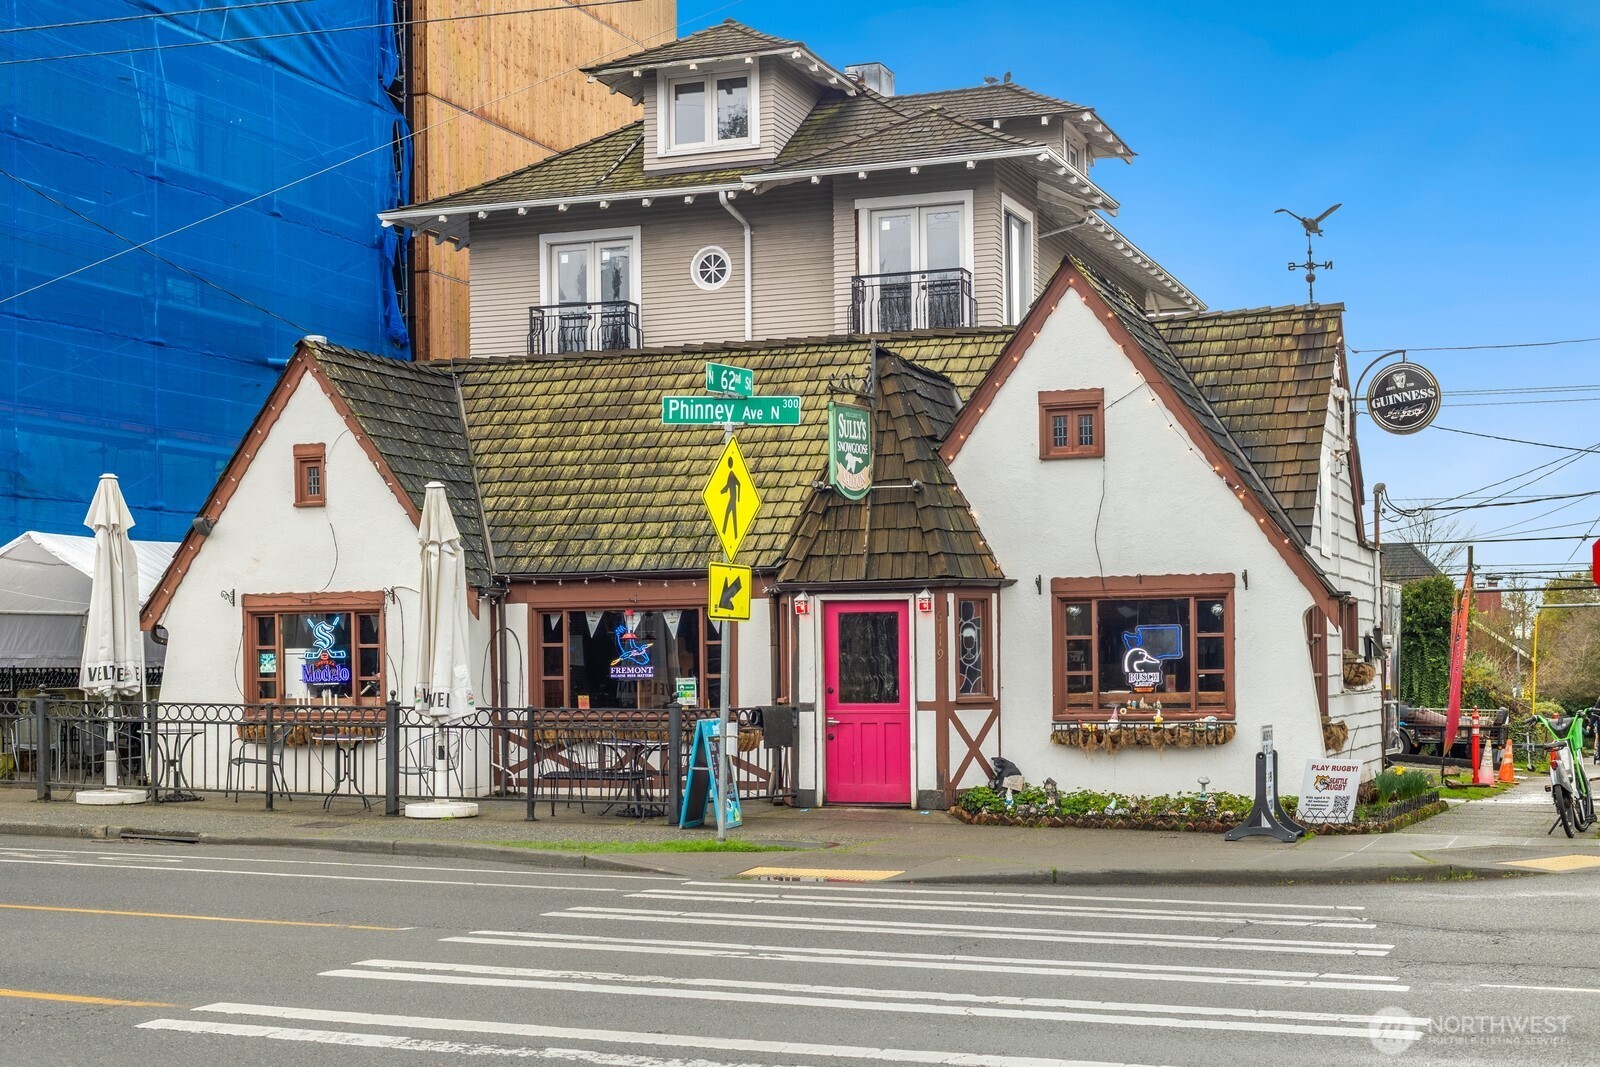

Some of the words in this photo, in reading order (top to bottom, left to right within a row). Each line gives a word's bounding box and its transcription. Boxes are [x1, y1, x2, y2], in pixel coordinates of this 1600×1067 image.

[708, 370, 714, 384] N
[721, 369, 741, 391] 62nd
[745, 376, 752, 390] St
[1371, 388, 1435, 409] GUINNESS
[669, 399, 735, 422] Phinney
[742, 406, 763, 420] Ave
[771, 406, 779, 420] N
[783, 399, 799, 408] 300
[838, 413, 867, 440] SULLY'S
[837, 441, 868, 455] SNOWGOOSE
[936, 611, 944, 660] 6119
[301, 664, 350, 683] Modelo
[610, 666, 654, 674] FREMONT
[1128, 672, 1160, 682] BUSCH
[1330, 777, 1348, 785] SEATTLE
